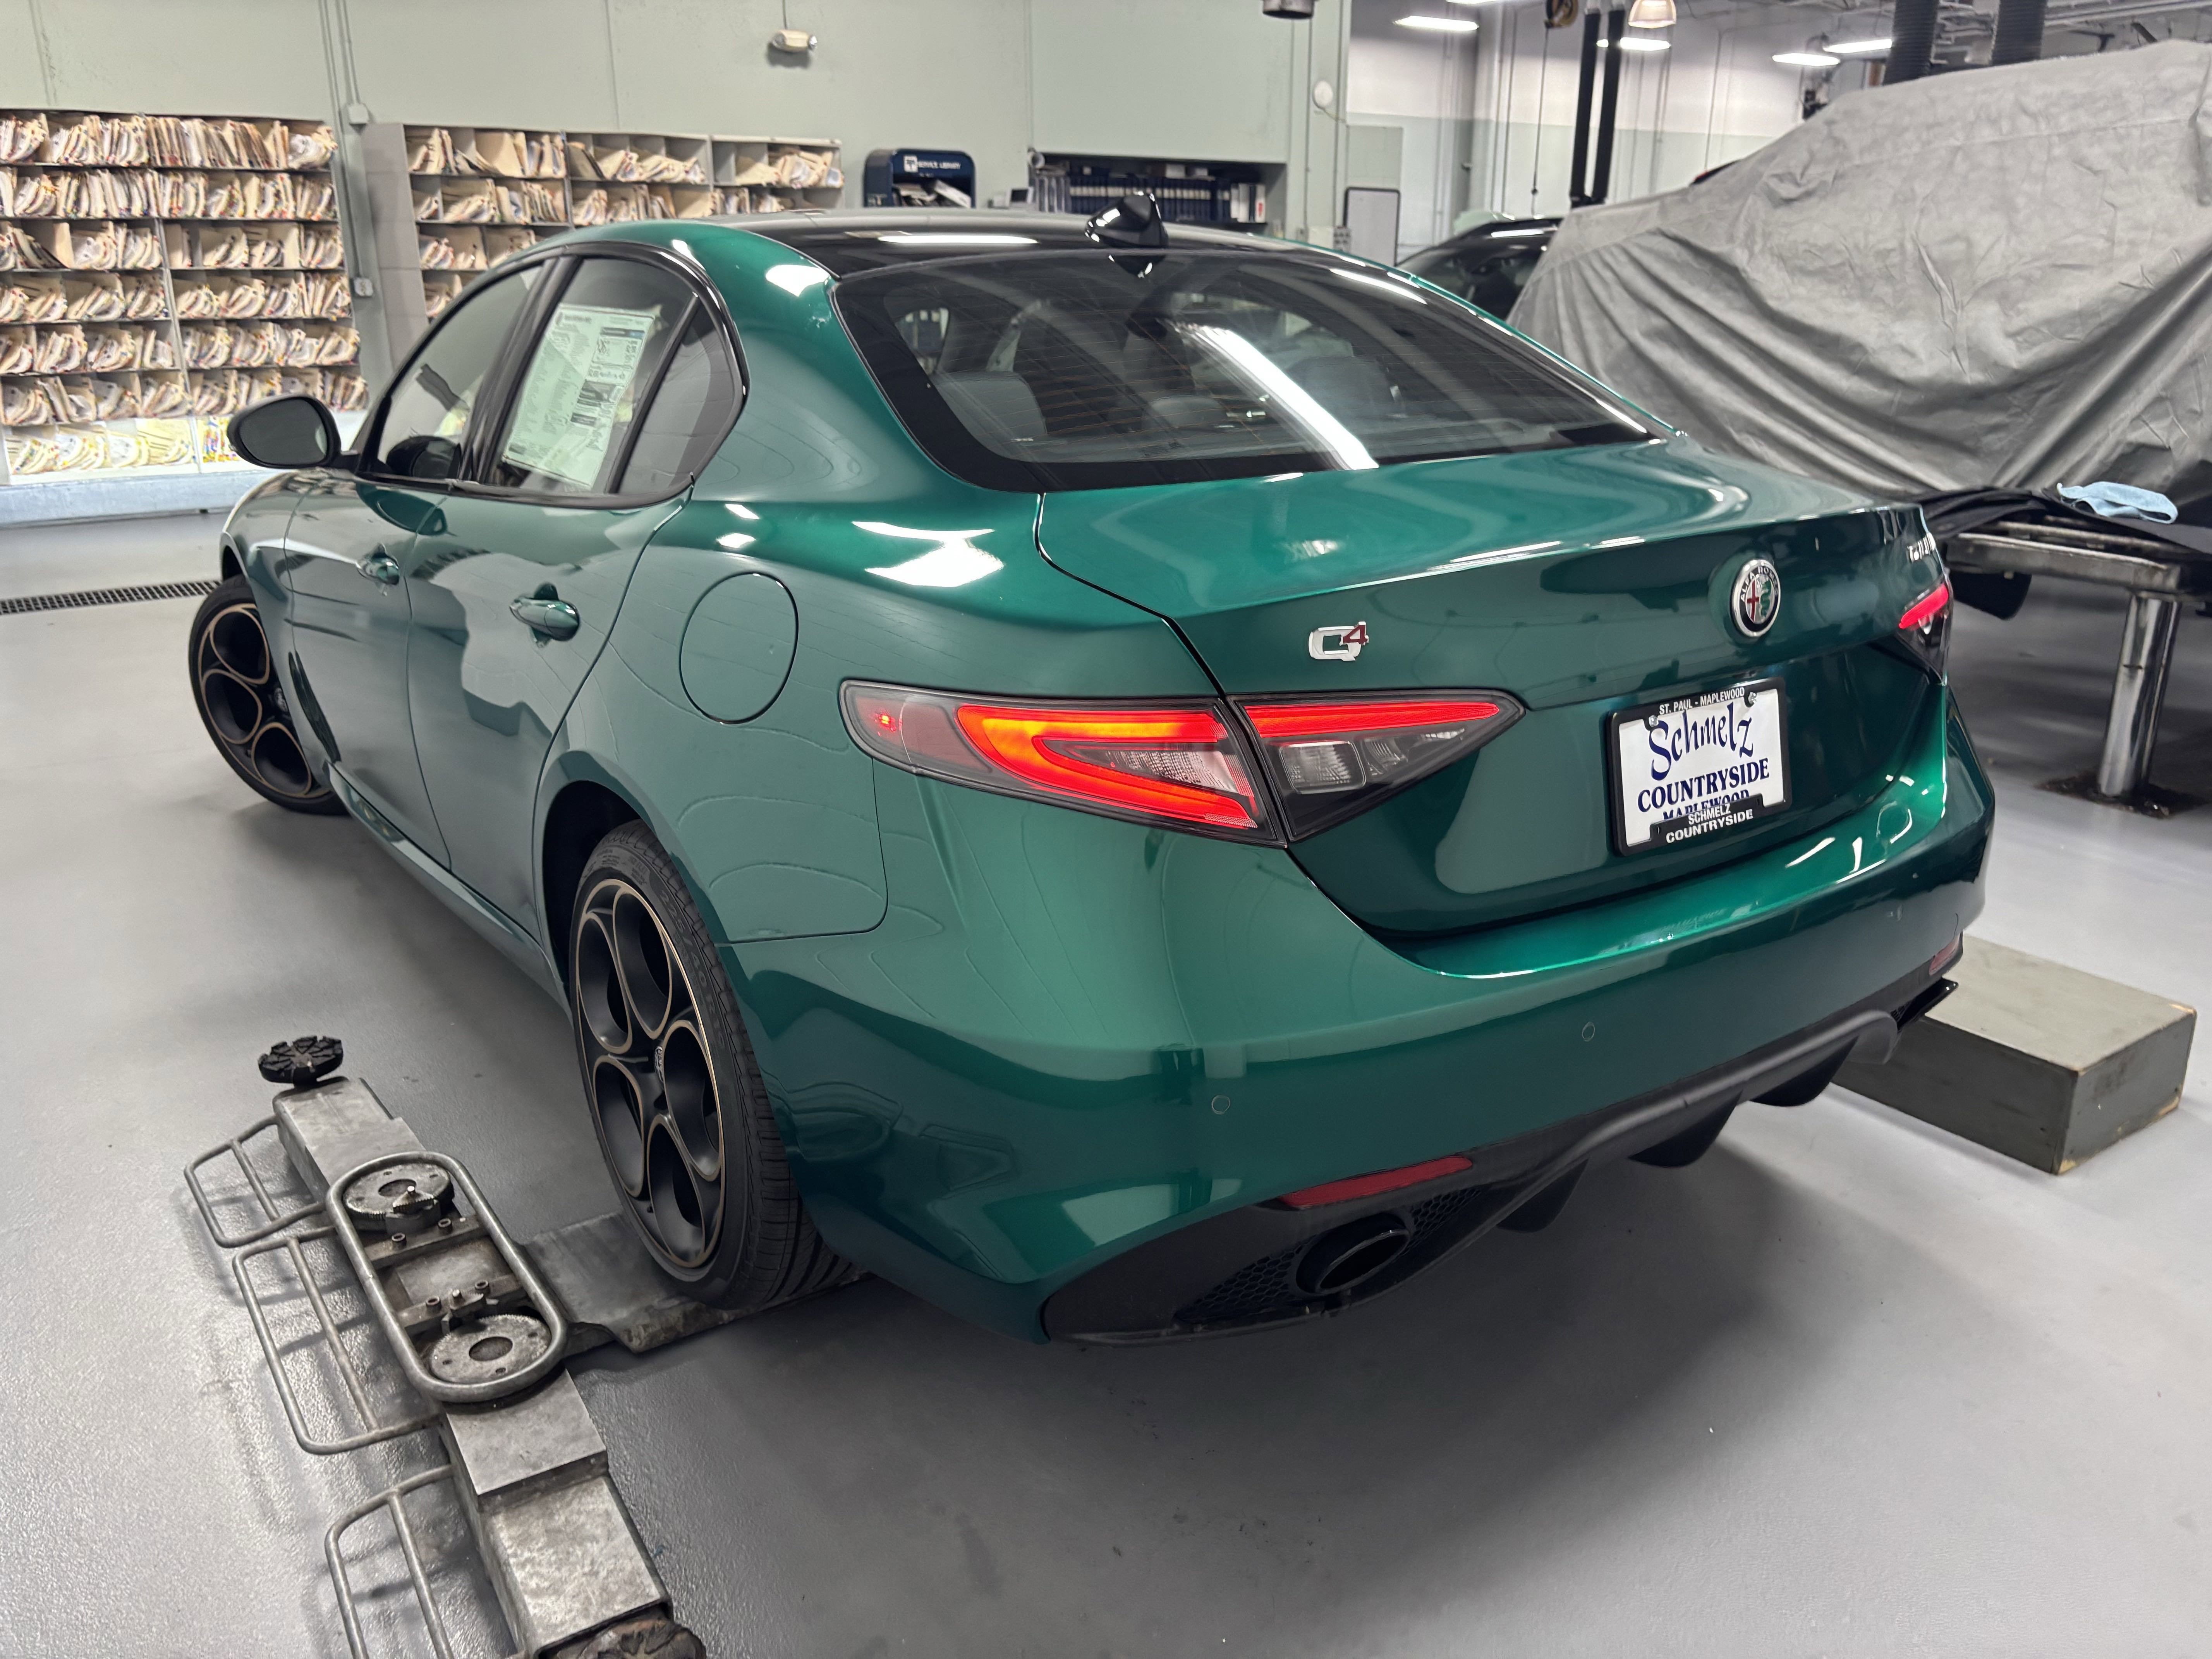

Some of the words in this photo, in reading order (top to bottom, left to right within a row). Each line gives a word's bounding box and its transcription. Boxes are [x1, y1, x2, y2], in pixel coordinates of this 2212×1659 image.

[1659, 703, 1672, 715] ST.
[1673, 698, 1693, 712] PAUL
[1700, 687, 1745, 706] MAPLEWOOD
[1649, 702, 1754, 781] Schmelz
[1638, 757, 1770, 812] COUNTRYSIDE
[1666, 809, 1754, 843] COUNTRYSIDE
[1688, 803, 1731, 825] SCHMELZ
